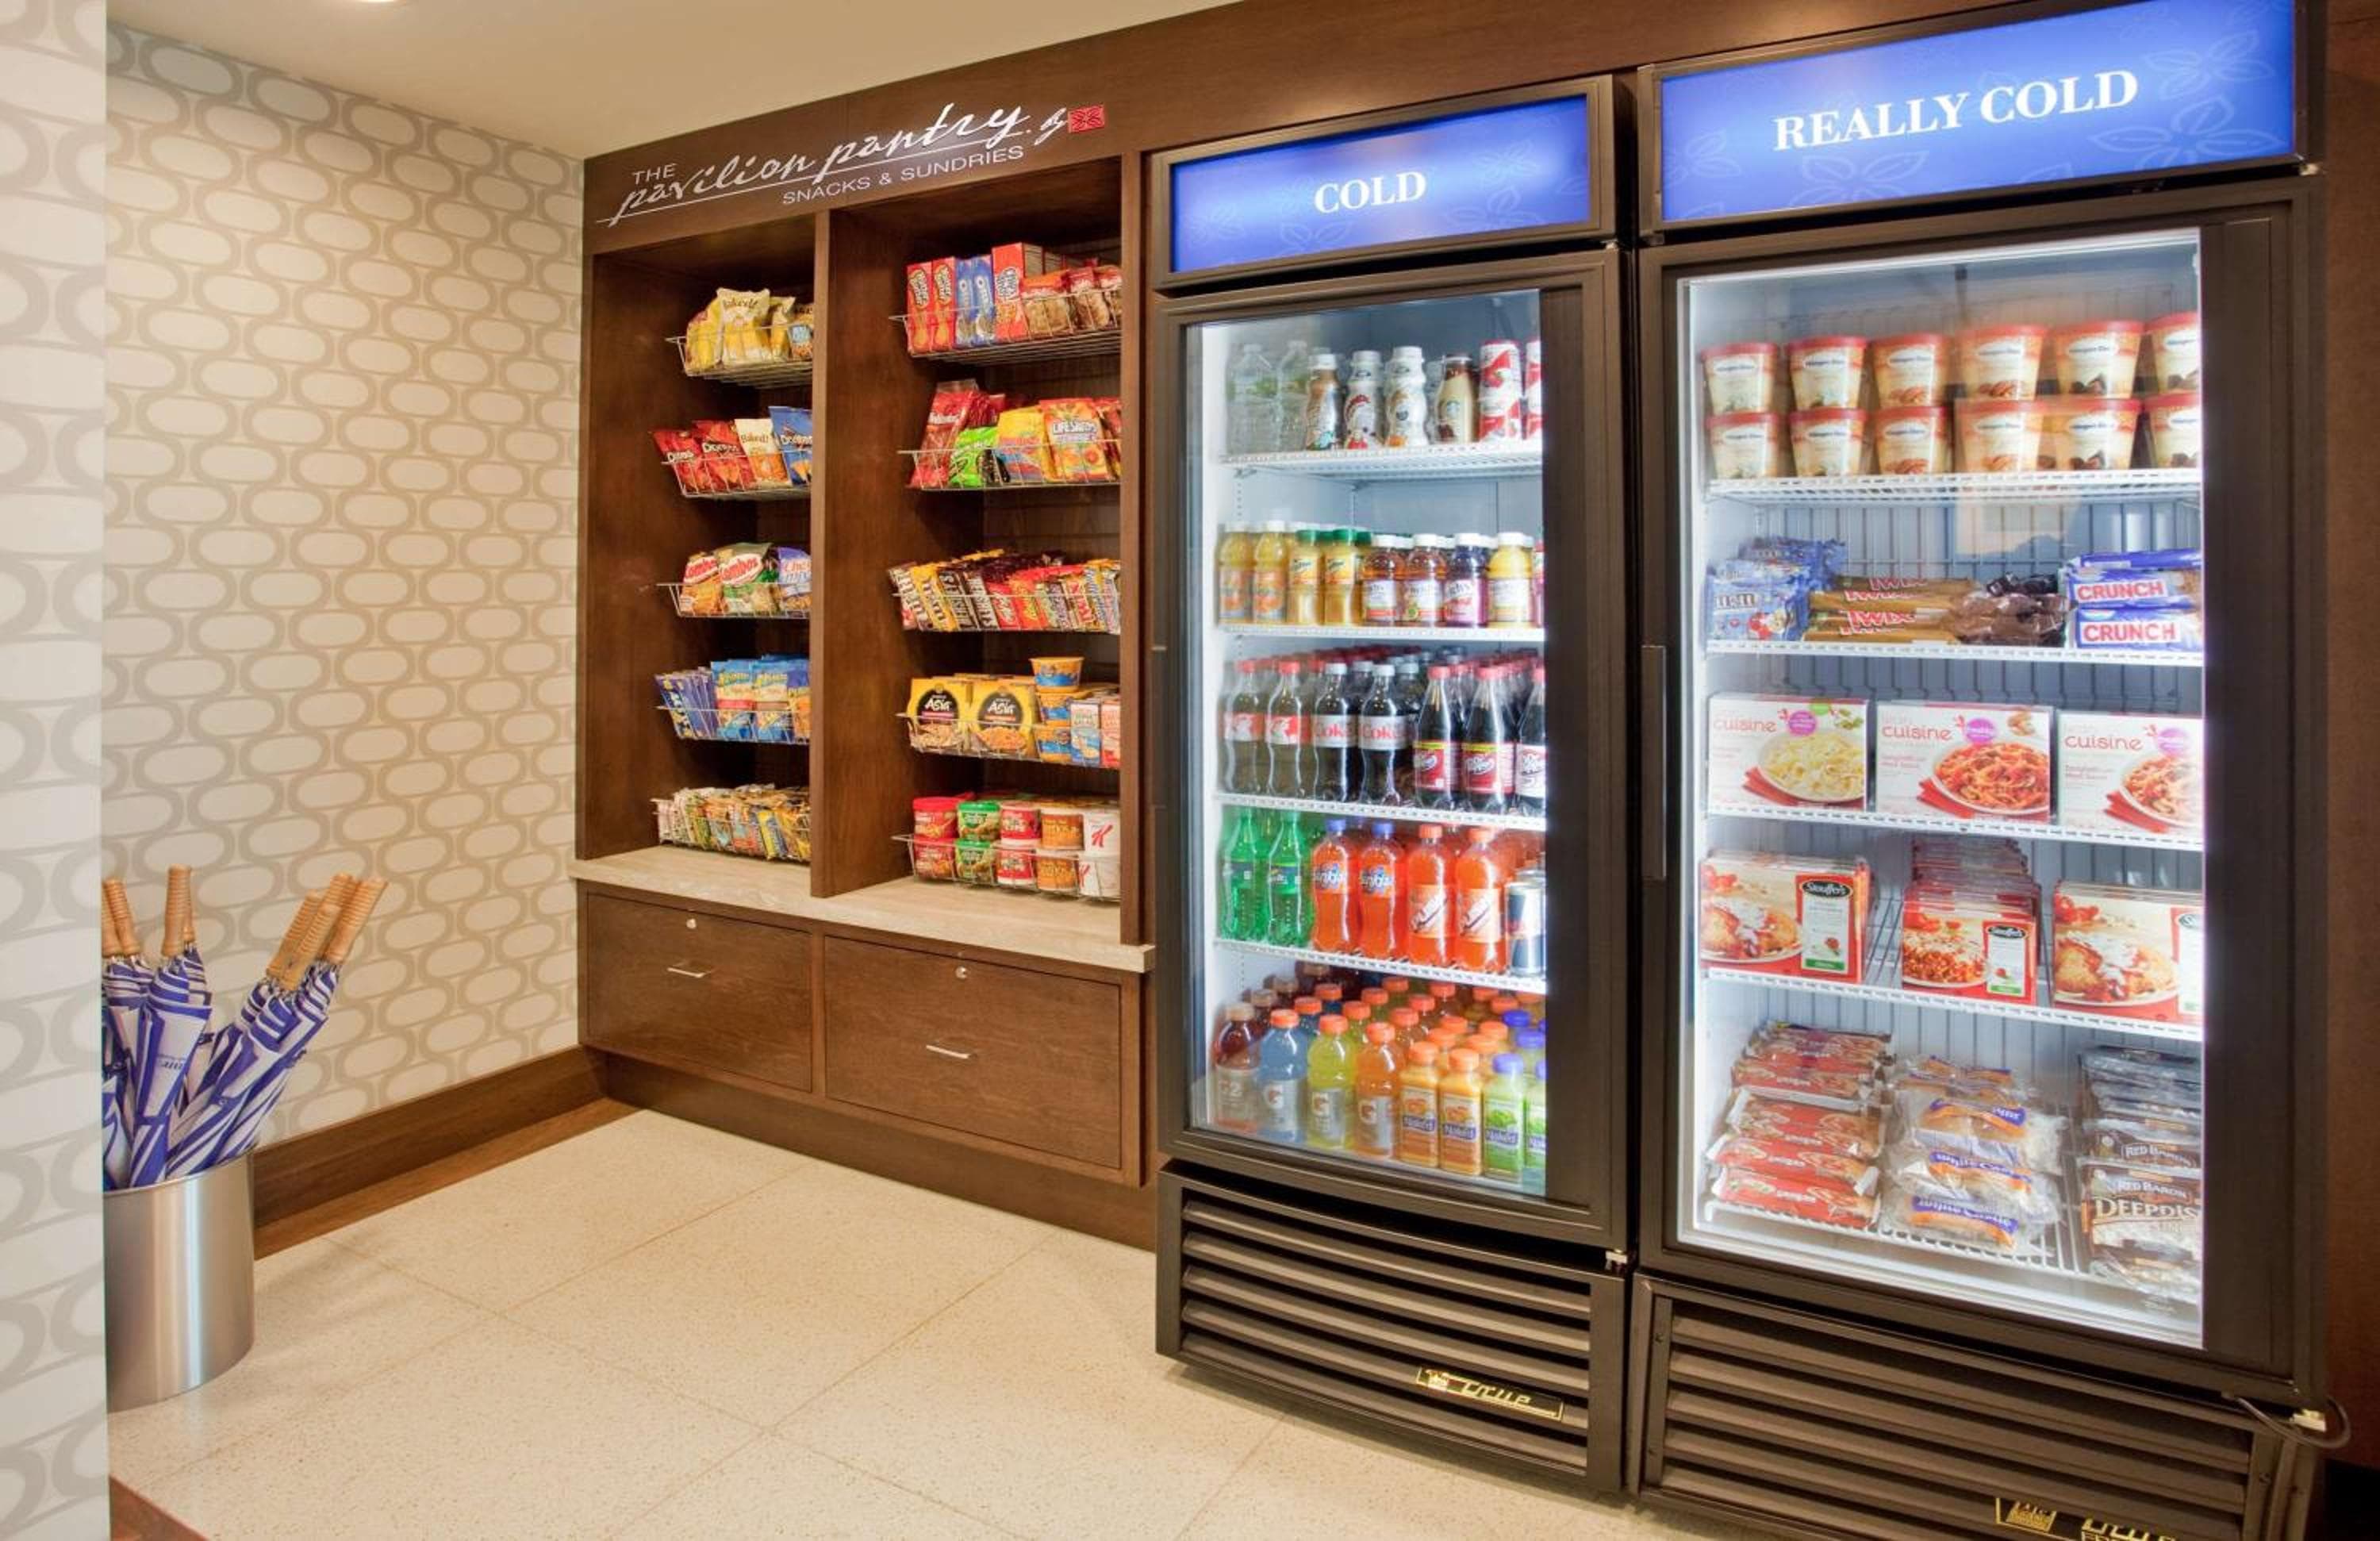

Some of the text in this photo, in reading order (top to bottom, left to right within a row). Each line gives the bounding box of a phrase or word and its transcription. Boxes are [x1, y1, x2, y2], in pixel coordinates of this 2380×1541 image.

[1772, 69, 2140, 152] REALLY COLD
[632, 162, 678, 185] THE
[782, 144, 1025, 206] SNACKS & SUNDRIES
[608, 153, 816, 229] pavilion
[1314, 171, 1427, 215] COLD
[2077, 581, 2164, 601] CRUNCH
[2082, 622, 2177, 643] CRUNCH
[1882, 725, 1952, 741] cuisine
[2063, 736, 2144, 751] cuisine
[2125, 1144, 2148, 1159] RED
[2094, 1196, 2198, 1219] DEEPDIS
